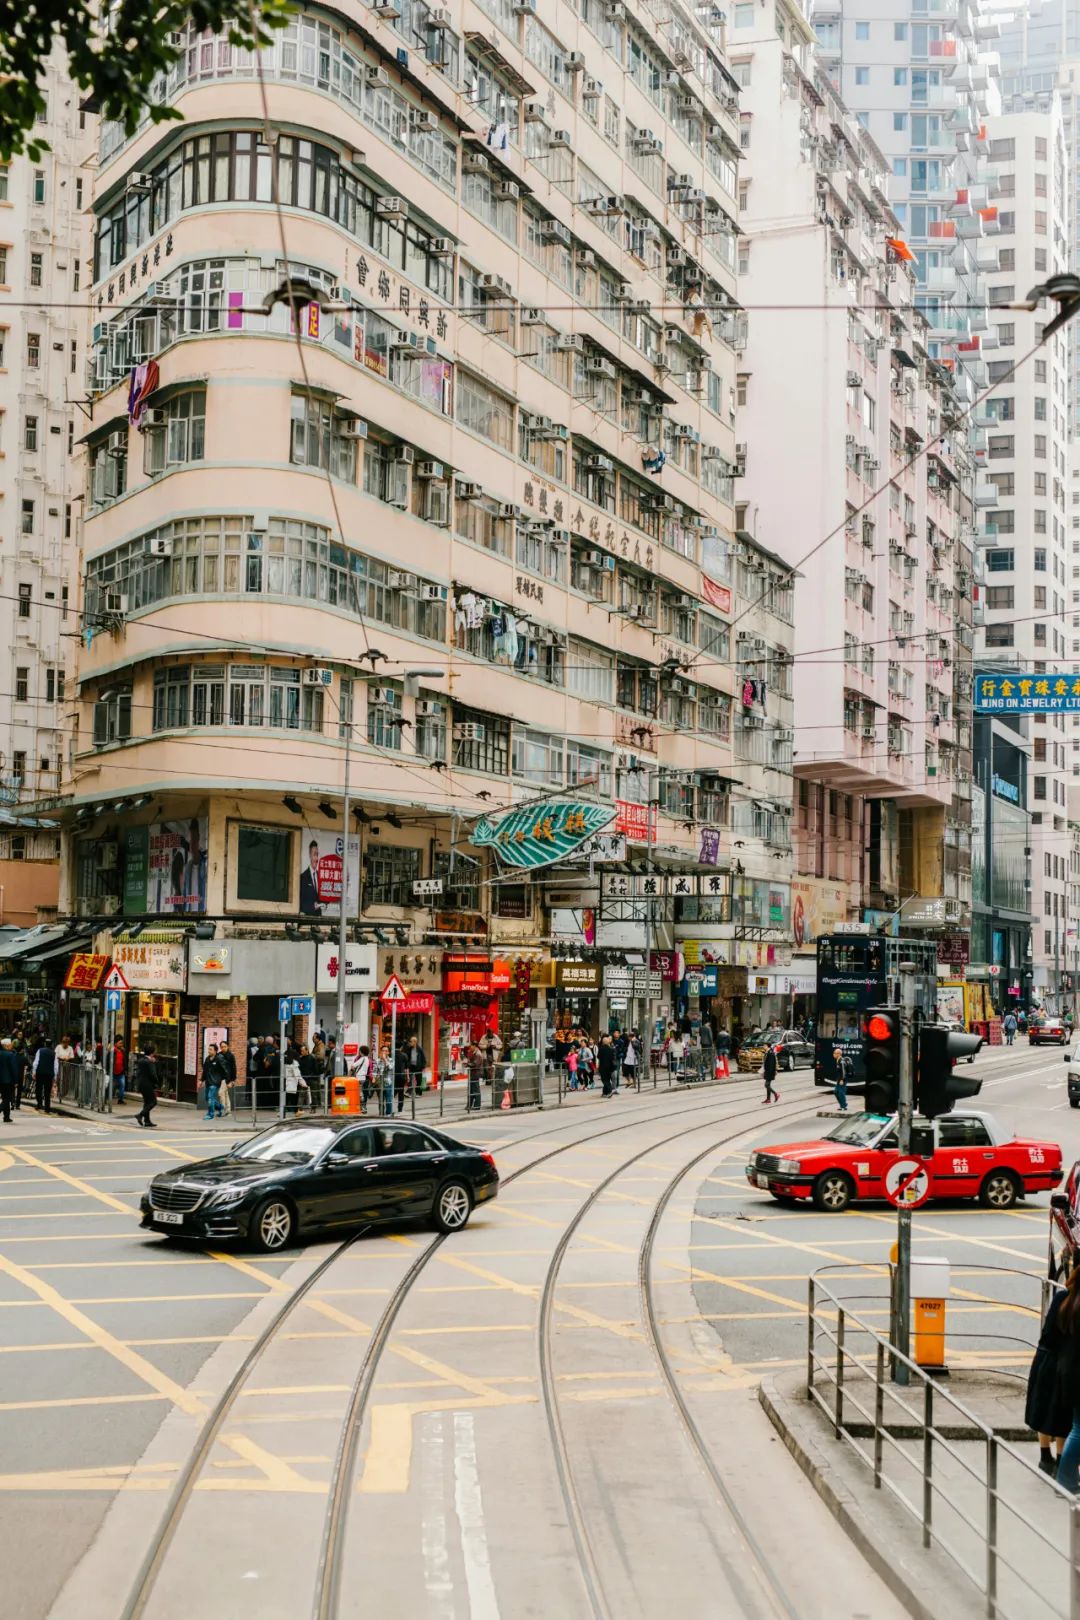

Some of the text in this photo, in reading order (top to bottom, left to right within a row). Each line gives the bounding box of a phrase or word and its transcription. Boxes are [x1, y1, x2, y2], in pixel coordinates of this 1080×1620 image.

[981, 698, 1004, 708] WING
[1006, 698, 1018, 708] ON
[1020, 698, 1063, 708] JEWELRY
[842, 924, 862, 932] 135
[70, 965, 98, 987] 蟹
[1028, 1147, 1044, 1156] 的士
[952, 1158, 968, 1166] 的士
[1030, 1155, 1045, 1163] TAXI
[953, 1165, 969, 1173] TAXI
